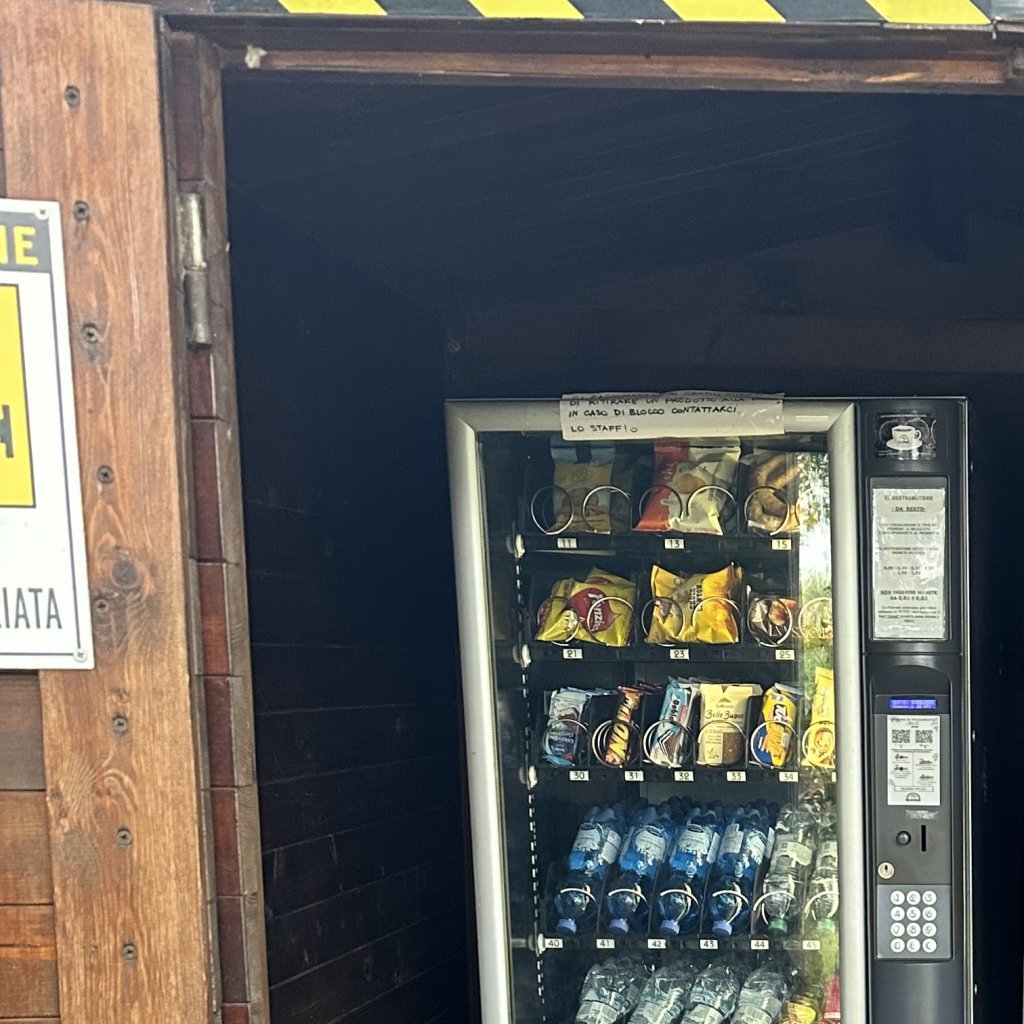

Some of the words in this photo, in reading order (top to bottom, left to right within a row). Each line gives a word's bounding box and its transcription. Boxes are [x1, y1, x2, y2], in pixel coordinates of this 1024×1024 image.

[568, 410, 579, 418] IN
[615, 409, 625, 417] DI
[629, 408, 665, 416] BLOCCO
[570, 425, 584, 433] LO
[0, 586, 63, 630] IATA
